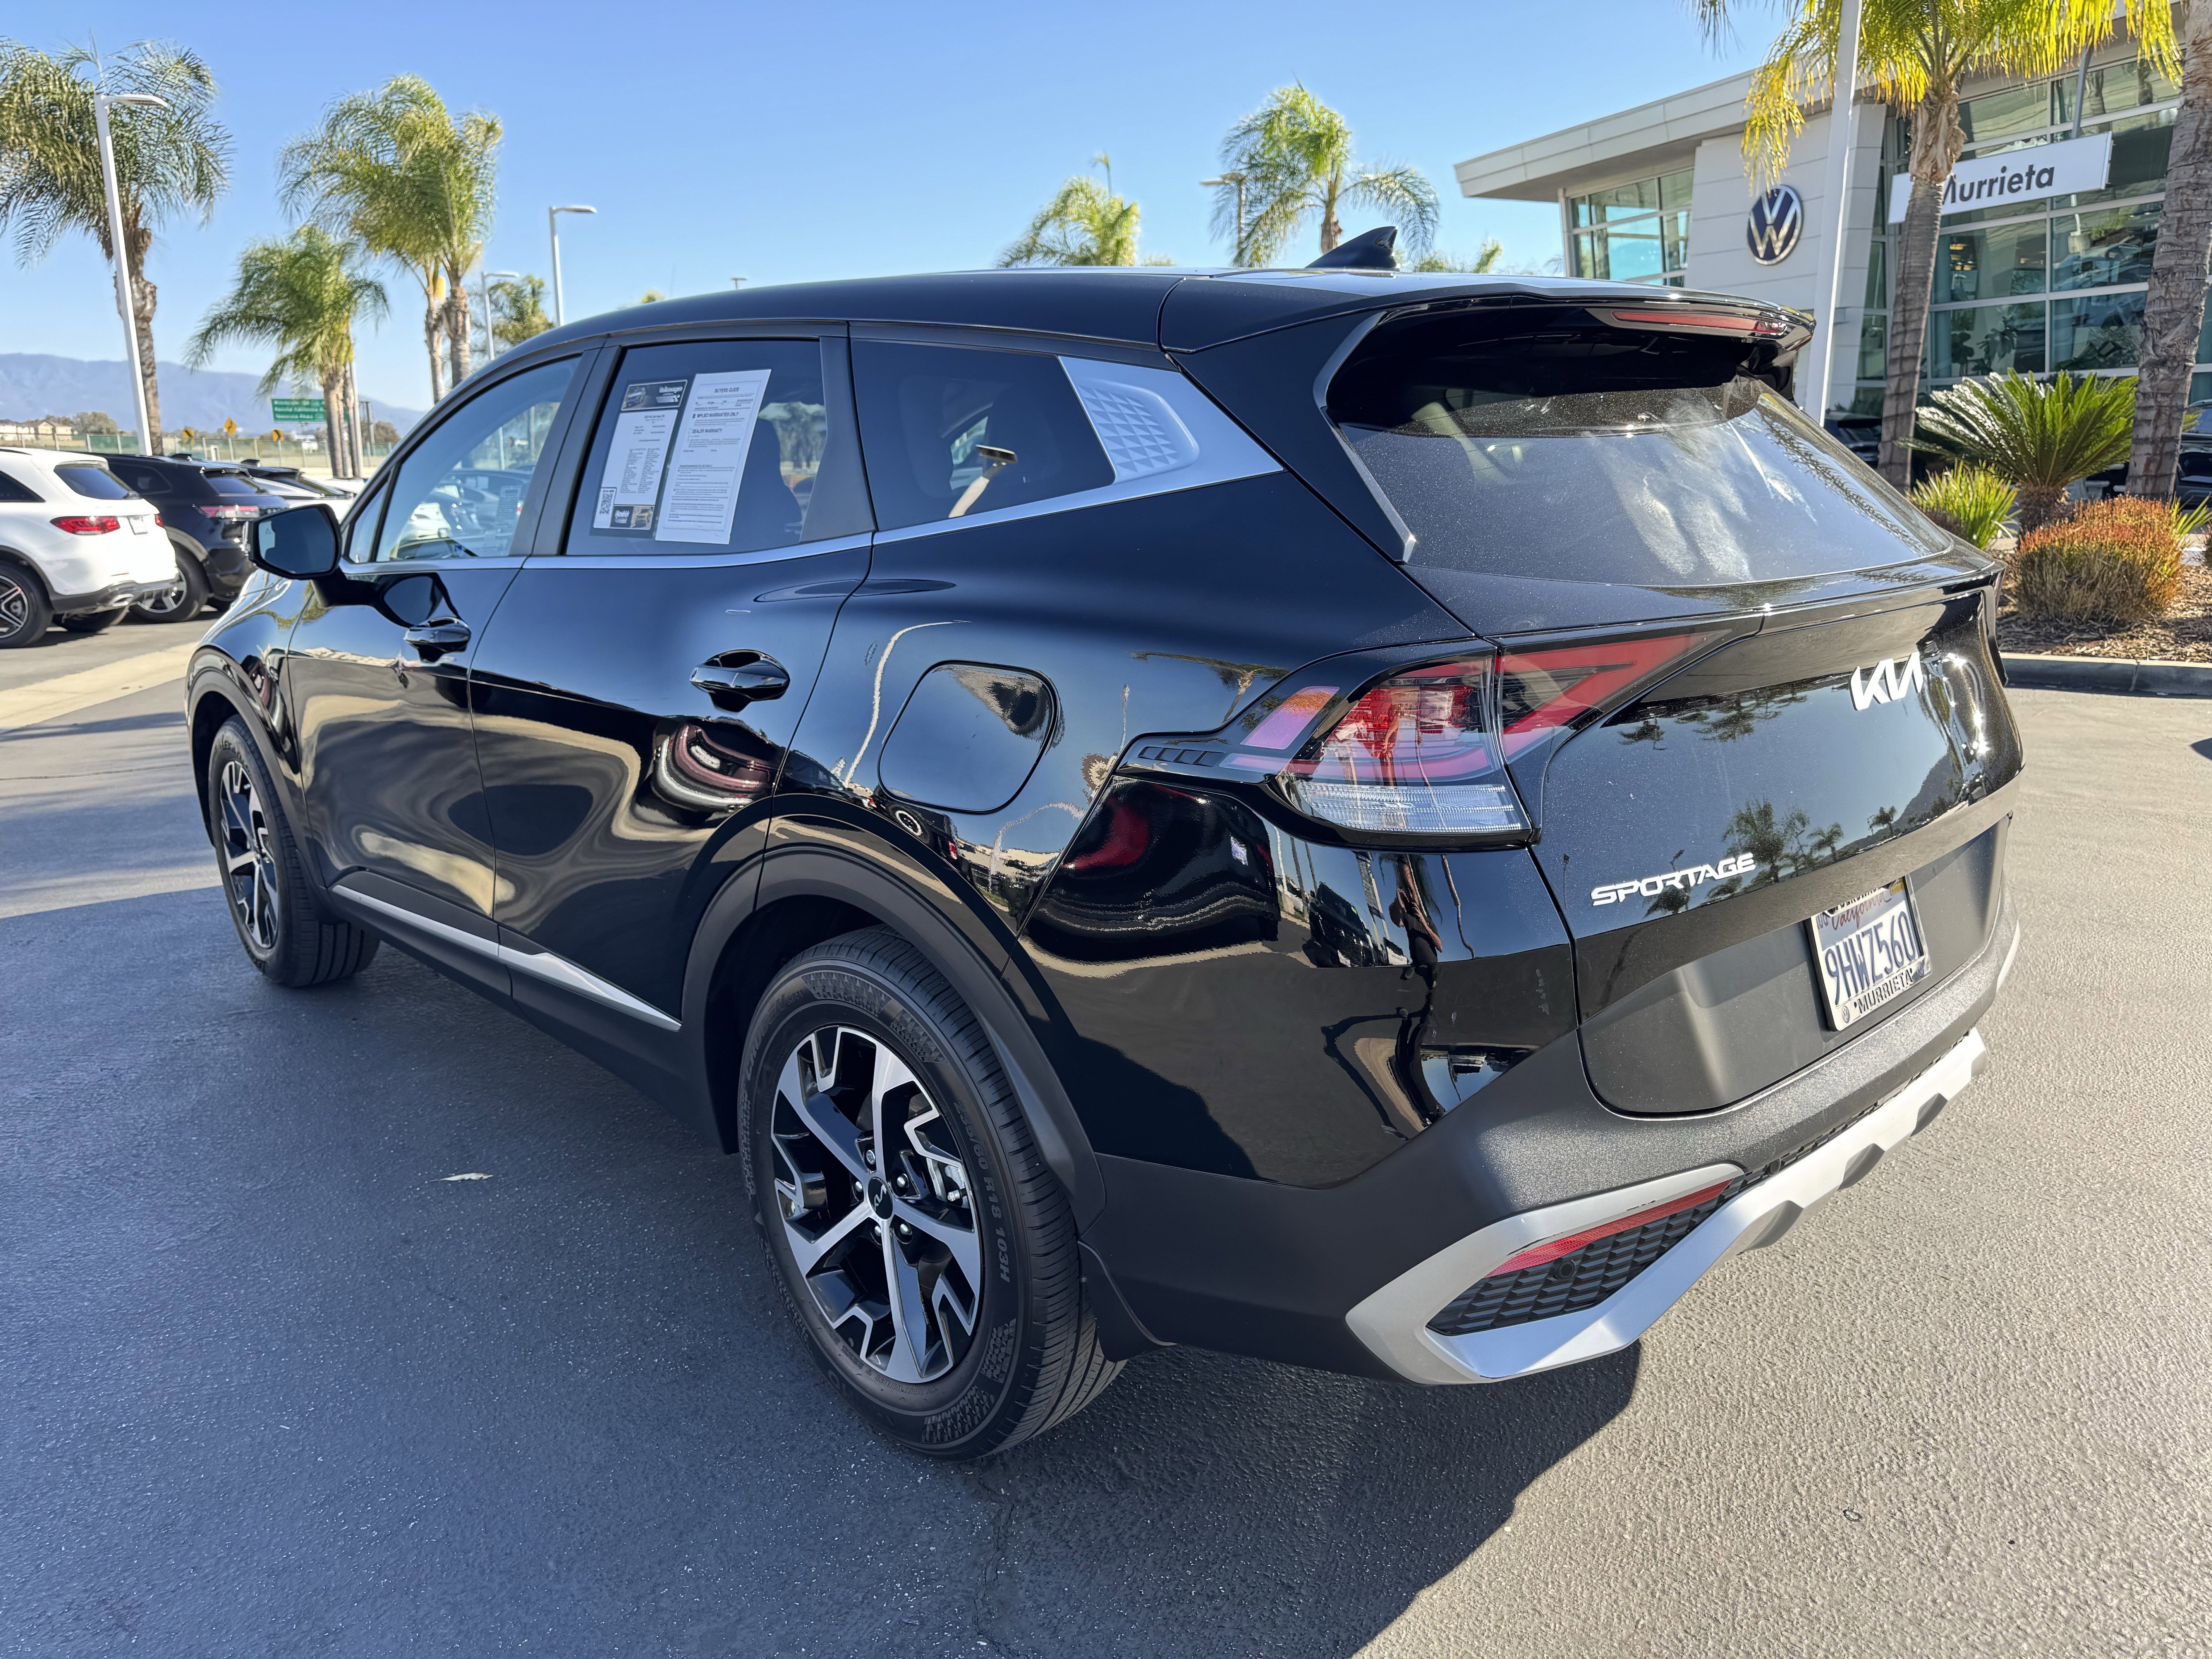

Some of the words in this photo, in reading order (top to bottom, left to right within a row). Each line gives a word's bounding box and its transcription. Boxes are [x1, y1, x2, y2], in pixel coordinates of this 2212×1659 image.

[1590, 852, 1756, 906] SPORTAGE
[1825, 911, 1916, 1006] 9HWZ560
[1857, 969, 1913, 1014] MURRIETA
[953, 1100, 989, 1170] 235/60
[984, 1176, 1002, 1219] R18
[996, 1226, 1010, 1283] 103H
